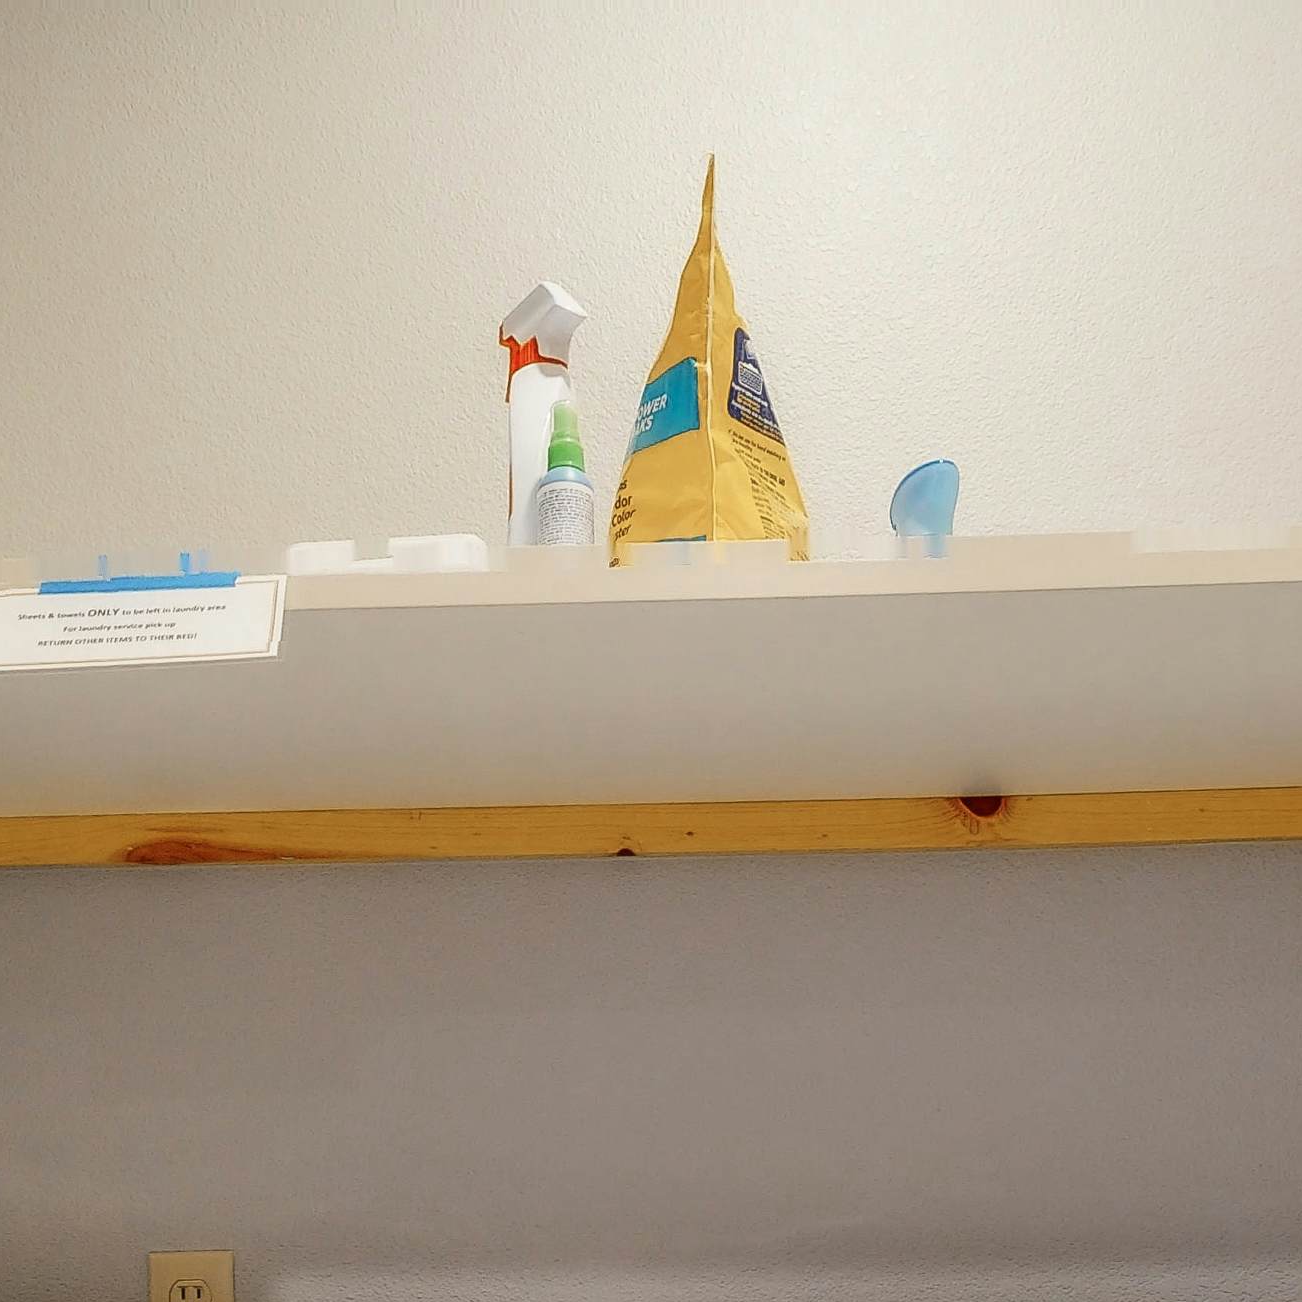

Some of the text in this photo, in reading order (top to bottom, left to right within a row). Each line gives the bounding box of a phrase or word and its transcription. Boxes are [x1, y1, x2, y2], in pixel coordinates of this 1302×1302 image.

[614, 495, 633, 510] dor
[611, 508, 637, 528] Color
[614, 524, 632, 542] ster
[87, 608, 120, 617] ONLY
